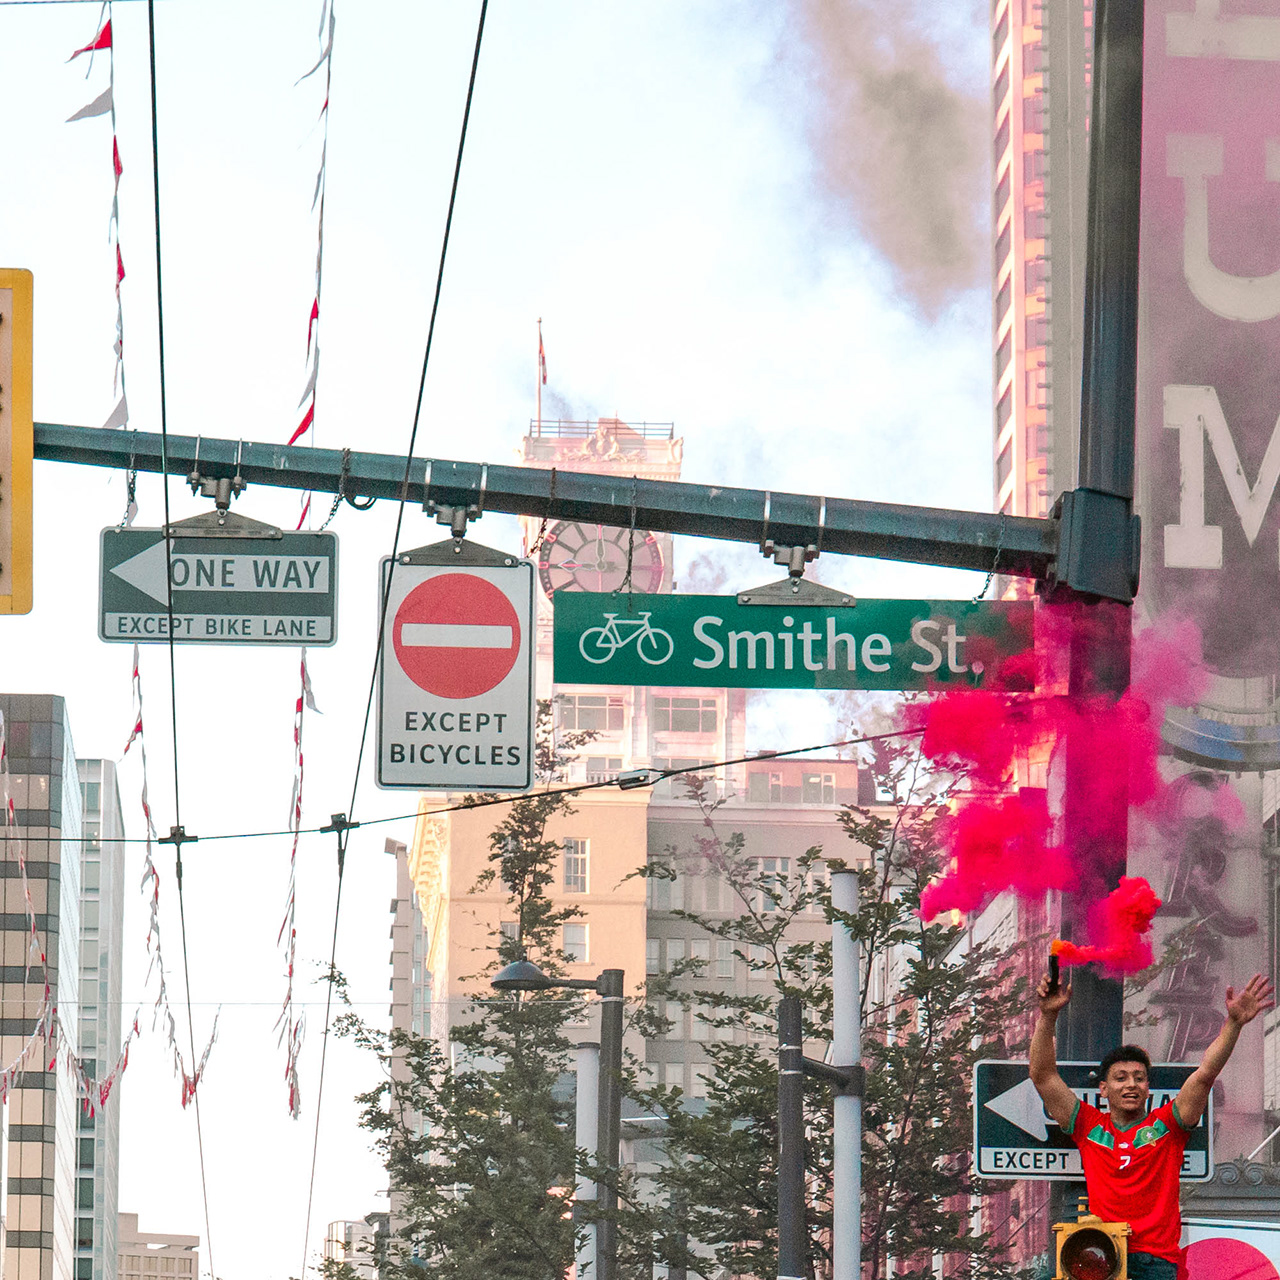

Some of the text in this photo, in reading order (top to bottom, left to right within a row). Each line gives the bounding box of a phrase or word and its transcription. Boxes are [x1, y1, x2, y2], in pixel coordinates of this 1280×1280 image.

[170, 558, 321, 588] ONE WAY
[118, 616, 316, 637] EXCEPT BIKE LANE
[692, 616, 984, 675] Smithe St.
[405, 711, 507, 733] EXCEPT
[390, 743, 521, 766] BICYCLES
[994, 1151, 1069, 1169] EXCEPT
[1119, 1155, 1131, 1170] 7
